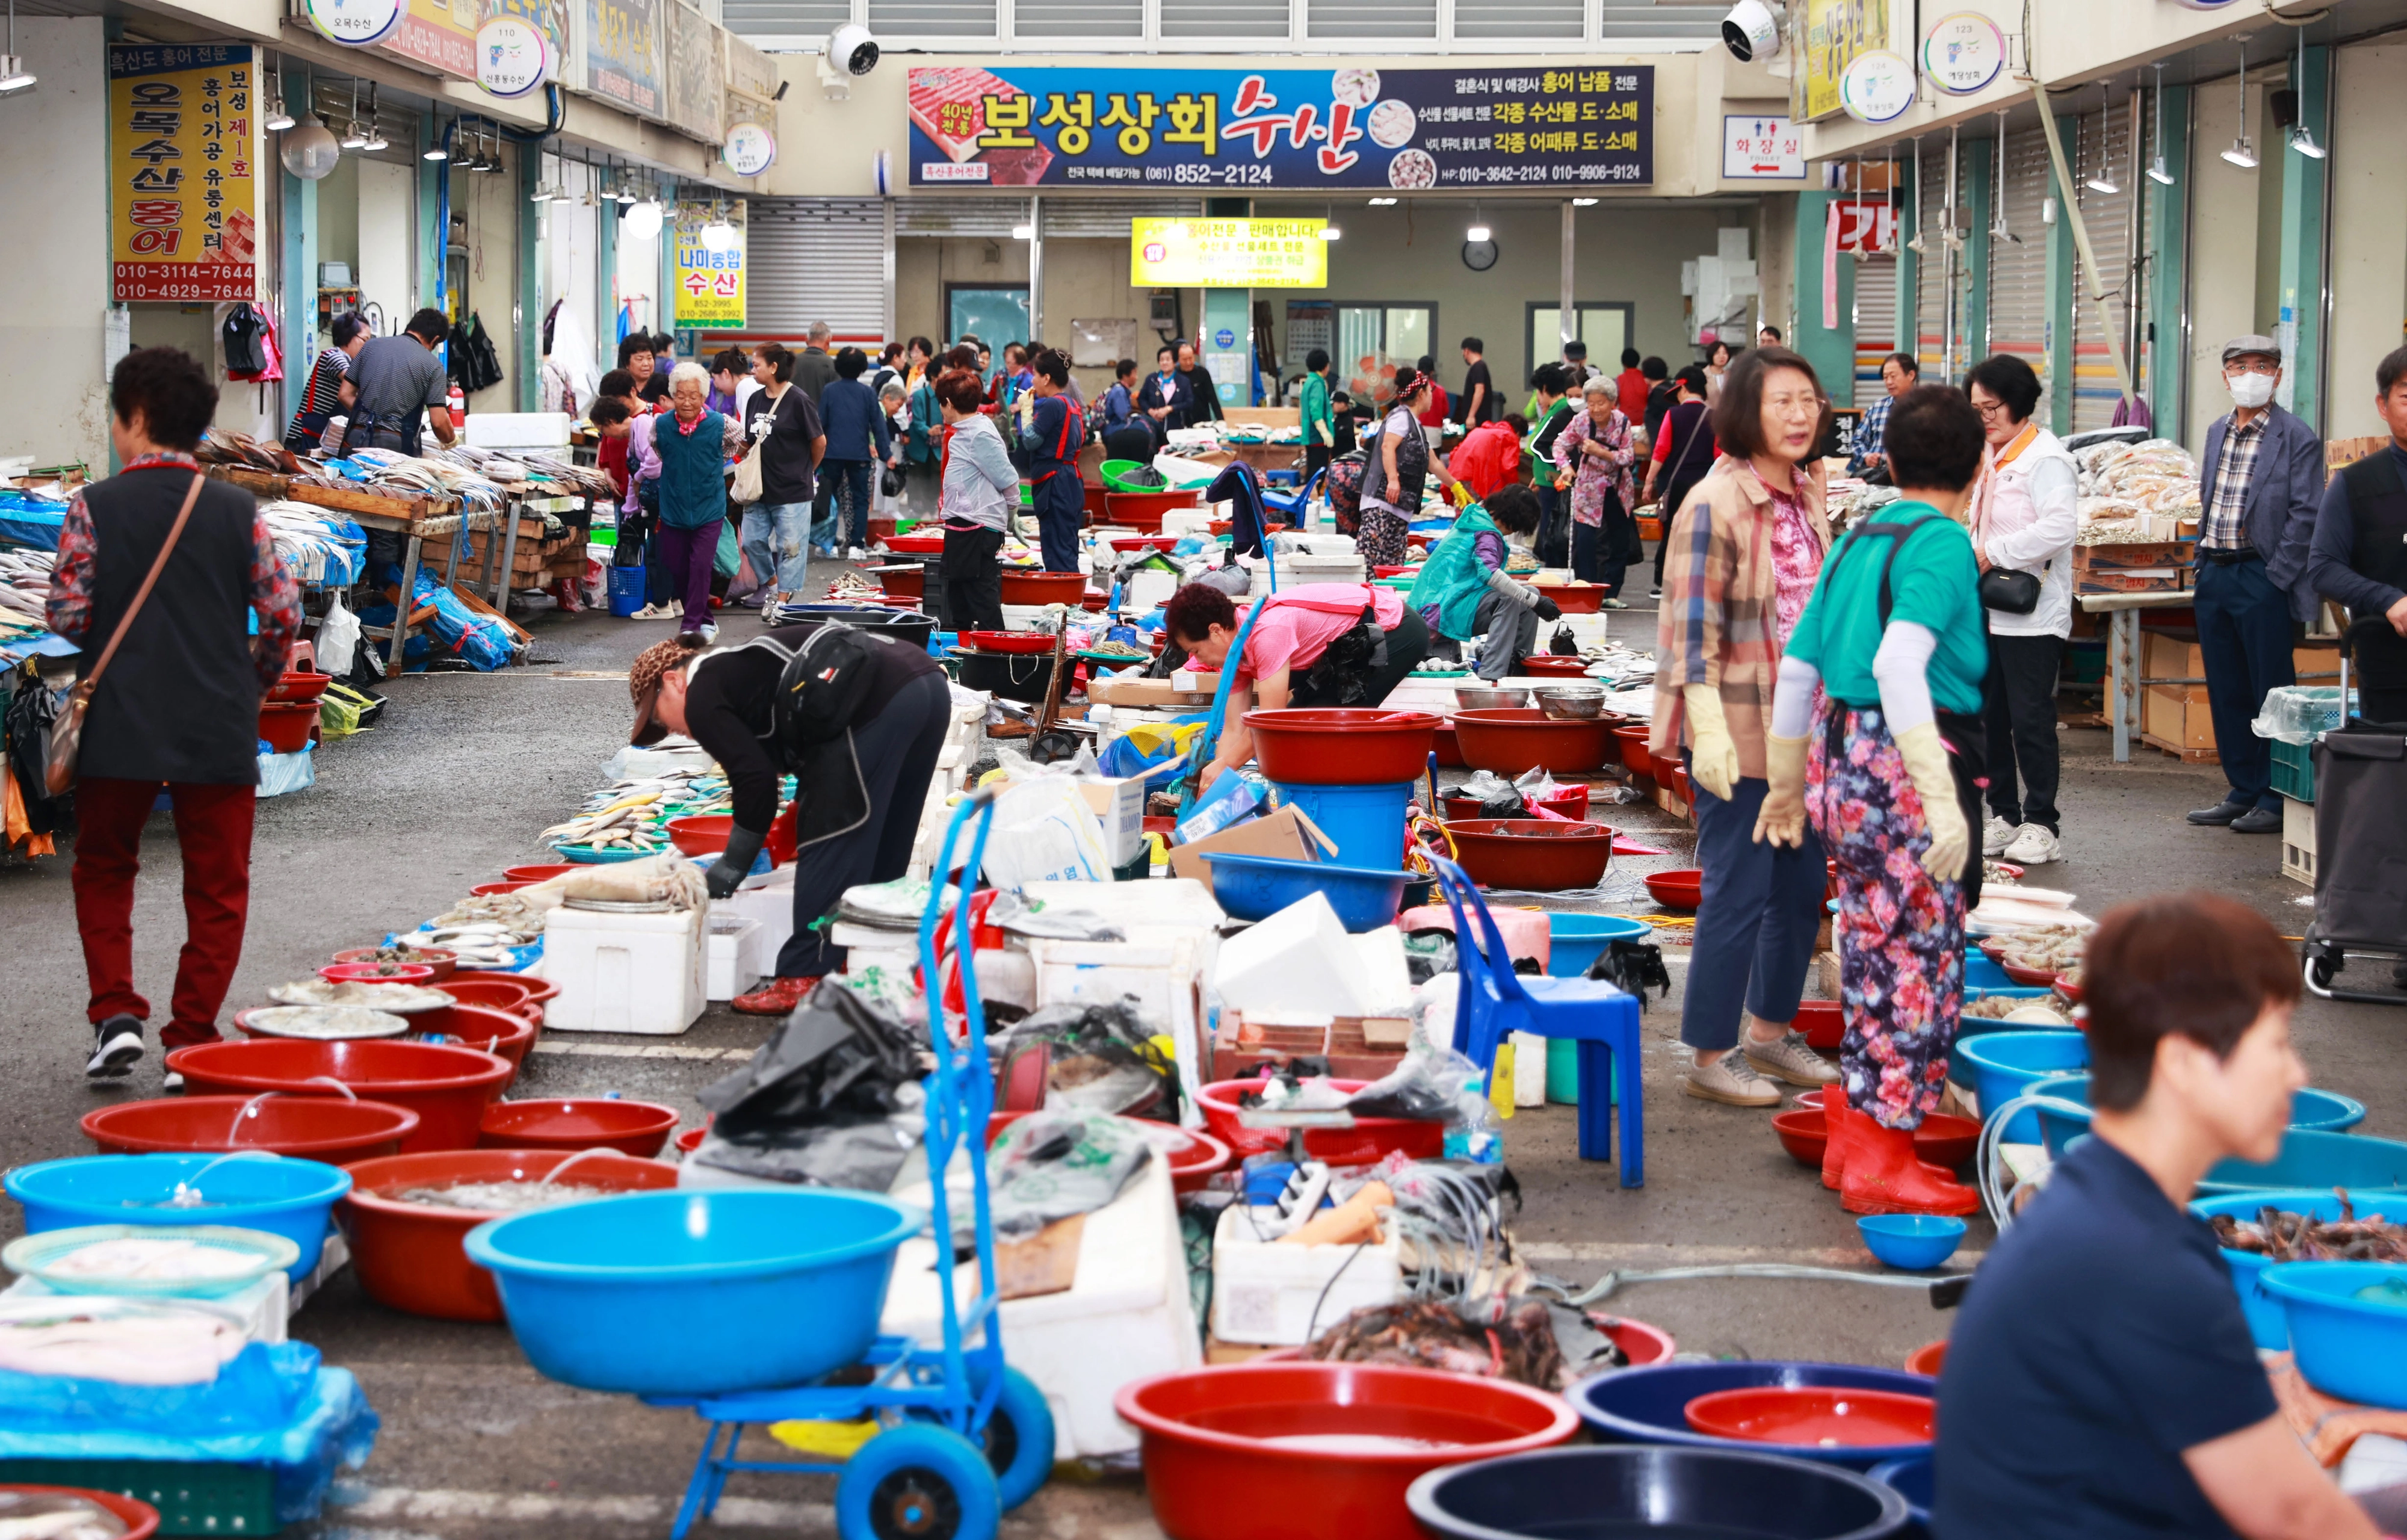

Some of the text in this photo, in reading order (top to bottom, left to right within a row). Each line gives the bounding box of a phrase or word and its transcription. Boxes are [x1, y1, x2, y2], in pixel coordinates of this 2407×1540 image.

[334, 17, 372, 30] 오목수산
[1956, 25, 1973, 34] 123
[498, 29, 515, 37] 110
[111, 46, 228, 73] 흑산도 홍어 전문
[1454, 70, 1638, 94] 결혼식 및 애경사 홍어 납품 전문
[202, 78, 224, 161] 홍어가공
[941, 103, 974, 121] 40년
[1418, 107, 1441, 122] 수산물
[1443, 106, 1474, 122] 선물세트
[1475, 106, 1491, 122] 전문
[1493, 102, 1526, 123] 각종
[1529, 101, 1577, 122] 수산물
[228, 70, 250, 178] 보성 제1호
[941, 120, 971, 137] 전통
[978, 75, 1362, 174] 보성상회 수산
[129, 81, 184, 193] 오목수산
[1494, 131, 1527, 153] 각종
[1529, 131, 1577, 152] 어패류
[1735, 138, 1797, 155] 화장실
[925, 164, 987, 179] 흑산홍어전문
[1068, 164, 1273, 183] 전국 택배 배달가능 (061) 852-2124
[1460, 165, 1547, 182] 010-3642-2124
[1552, 164, 1640, 180] 010-9906-9124
[202, 168, 224, 251] 유통센터
[129, 199, 182, 255] 홍어
[1249, 223, 1318, 238] 판매합니다.
[1237, 242, 1279, 252] 선물세트
[1283, 242, 1304, 252] 전문
[680, 249, 741, 268] 나미종합
[117, 265, 253, 279] 010-3114-7644
[117, 285, 253, 297] 010-4929-7644
[685, 273, 736, 295] 수산
[2134, 553, 2153, 564] 멸치
